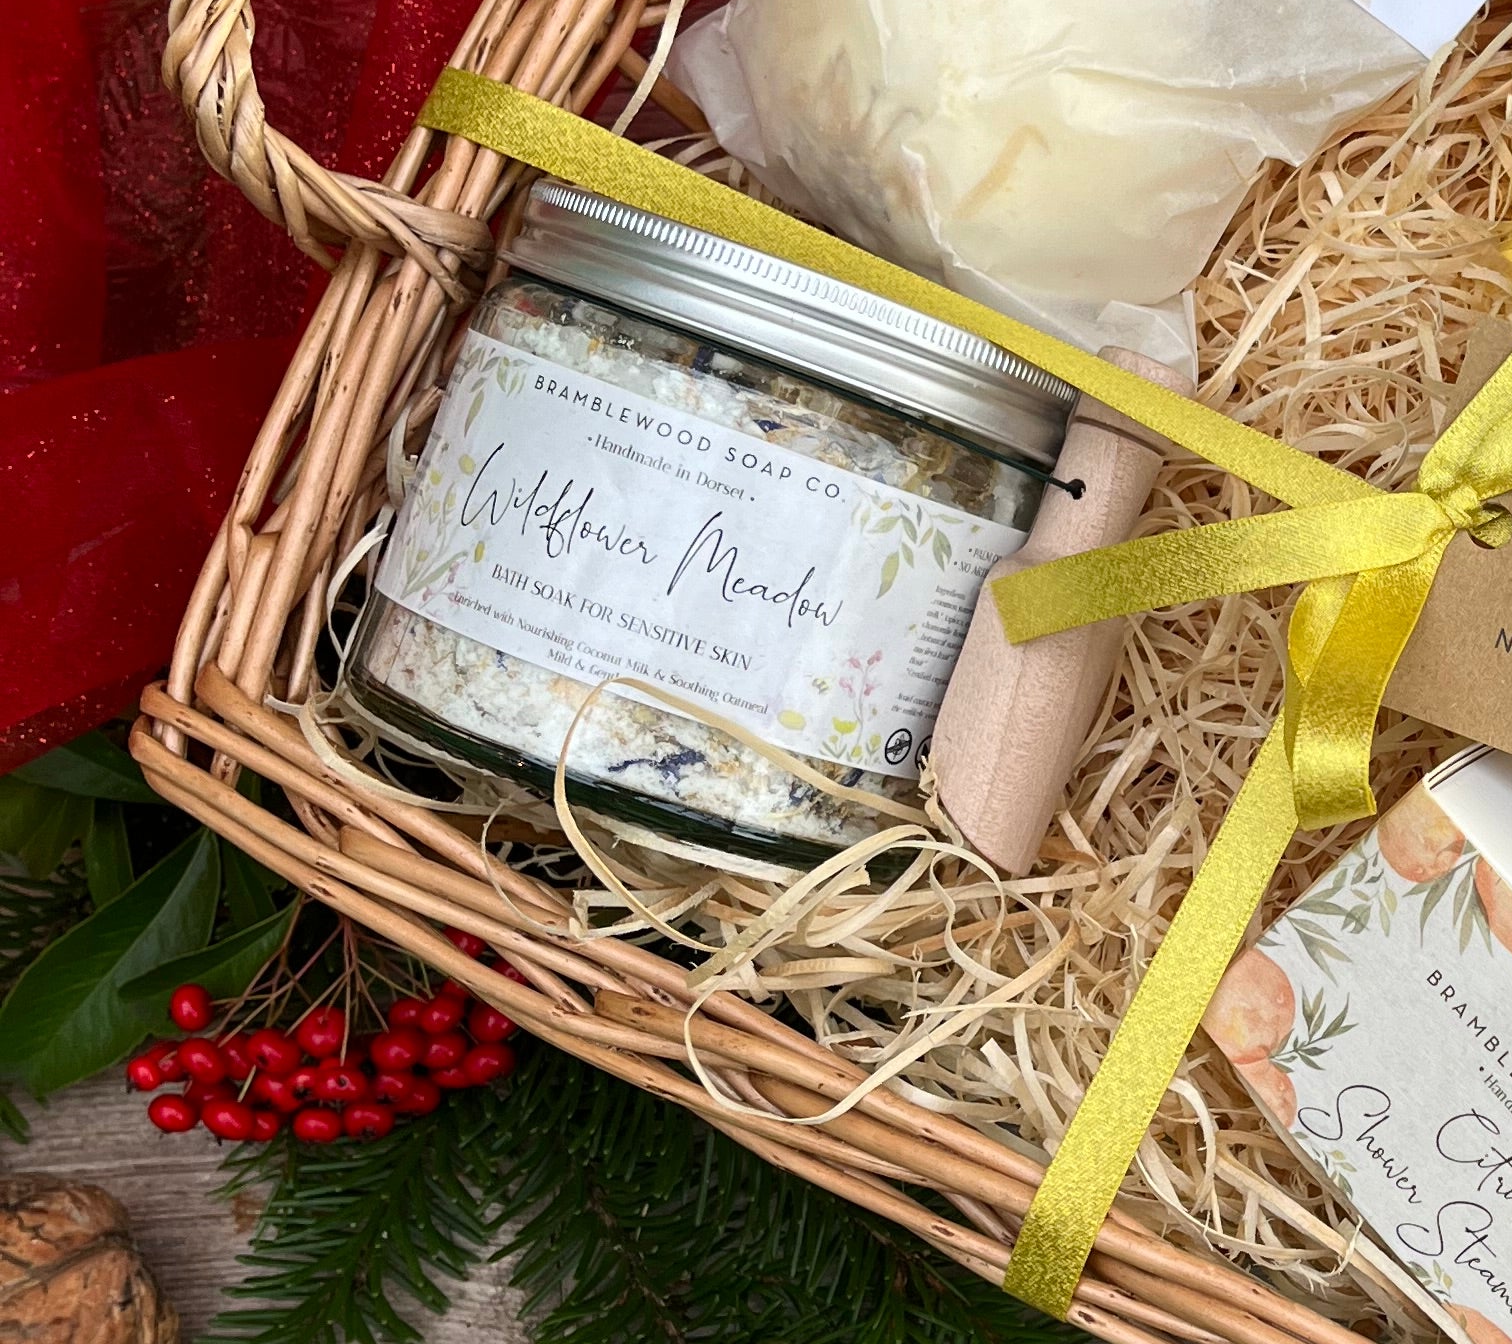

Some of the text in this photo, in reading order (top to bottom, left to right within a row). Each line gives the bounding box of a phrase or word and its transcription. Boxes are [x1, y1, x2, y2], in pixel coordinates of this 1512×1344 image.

[534, 374, 846, 503] BRAMBLEWOOD SOAP CO.
[595, 433, 746, 502] Handmade in Dorset
[460, 442, 844, 628] Wildflower Meadow
[453, 591, 768, 715] Enriched with Nourishing Coconut Milk & Soothing Oatmeal
[491, 563, 753, 673] BATH SOAK FOR SENSITIVE SKIN
[547, 648, 573, 666] Mild
[575, 659, 585, 671] &
[1297, 1084, 1422, 1204] Shower
